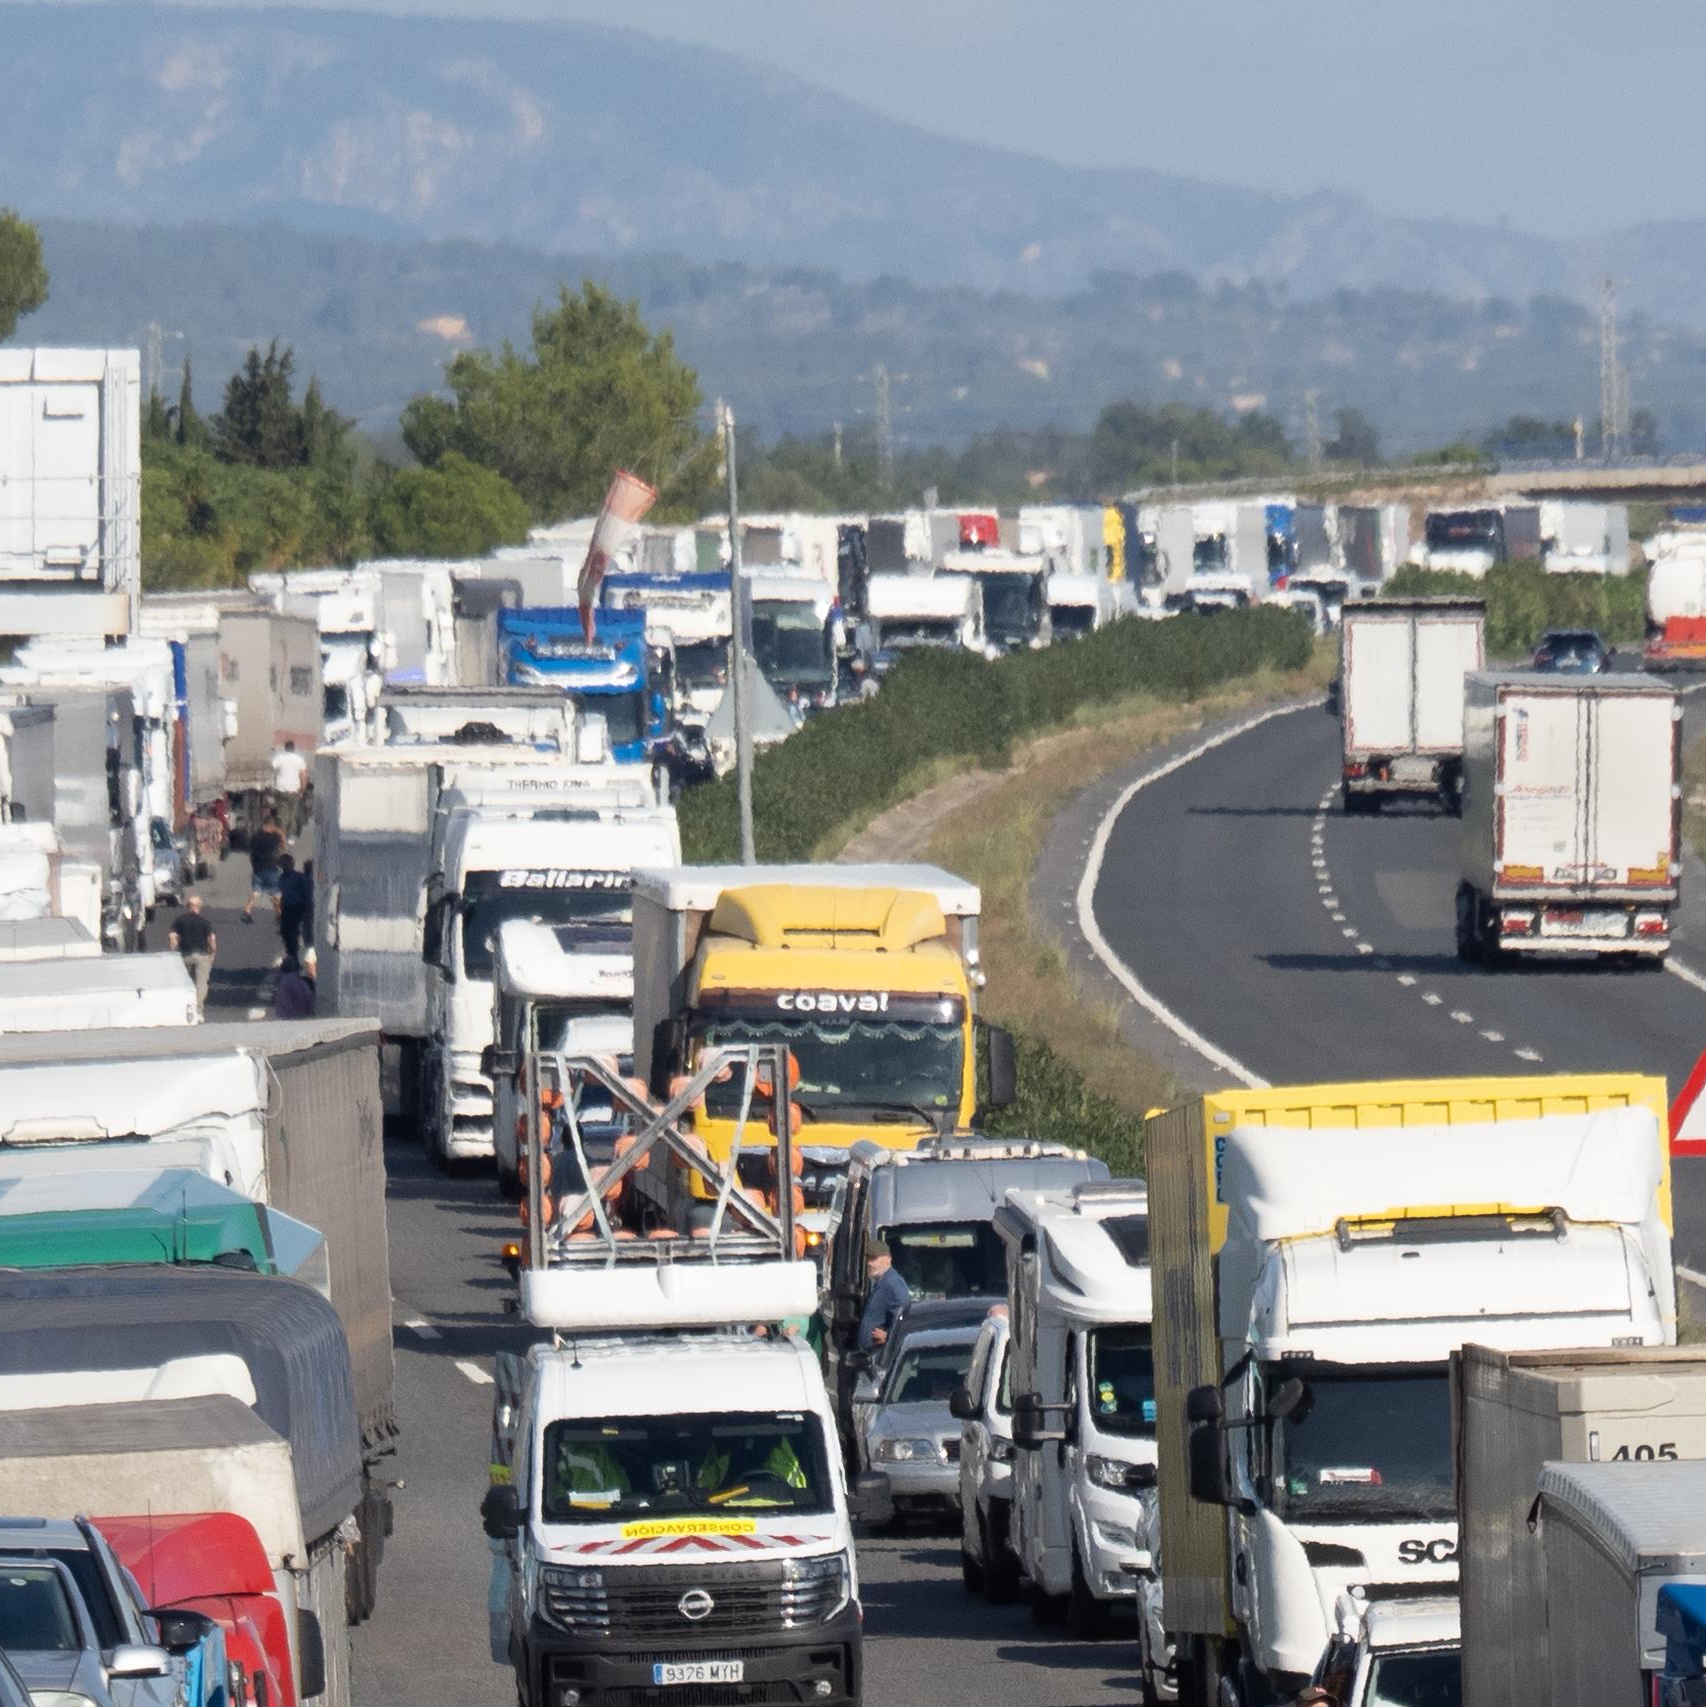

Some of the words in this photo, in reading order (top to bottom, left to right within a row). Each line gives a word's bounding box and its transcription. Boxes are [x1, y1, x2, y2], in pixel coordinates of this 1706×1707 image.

[508, 779, 558, 791] THERMO
[563, 779, 590, 790] KING
[777, 992, 889, 1013] coaval
[1611, 1442, 1679, 1461] 405
[1398, 1538, 1460, 1565] SC
[710, 1663, 739, 1680] MYH
